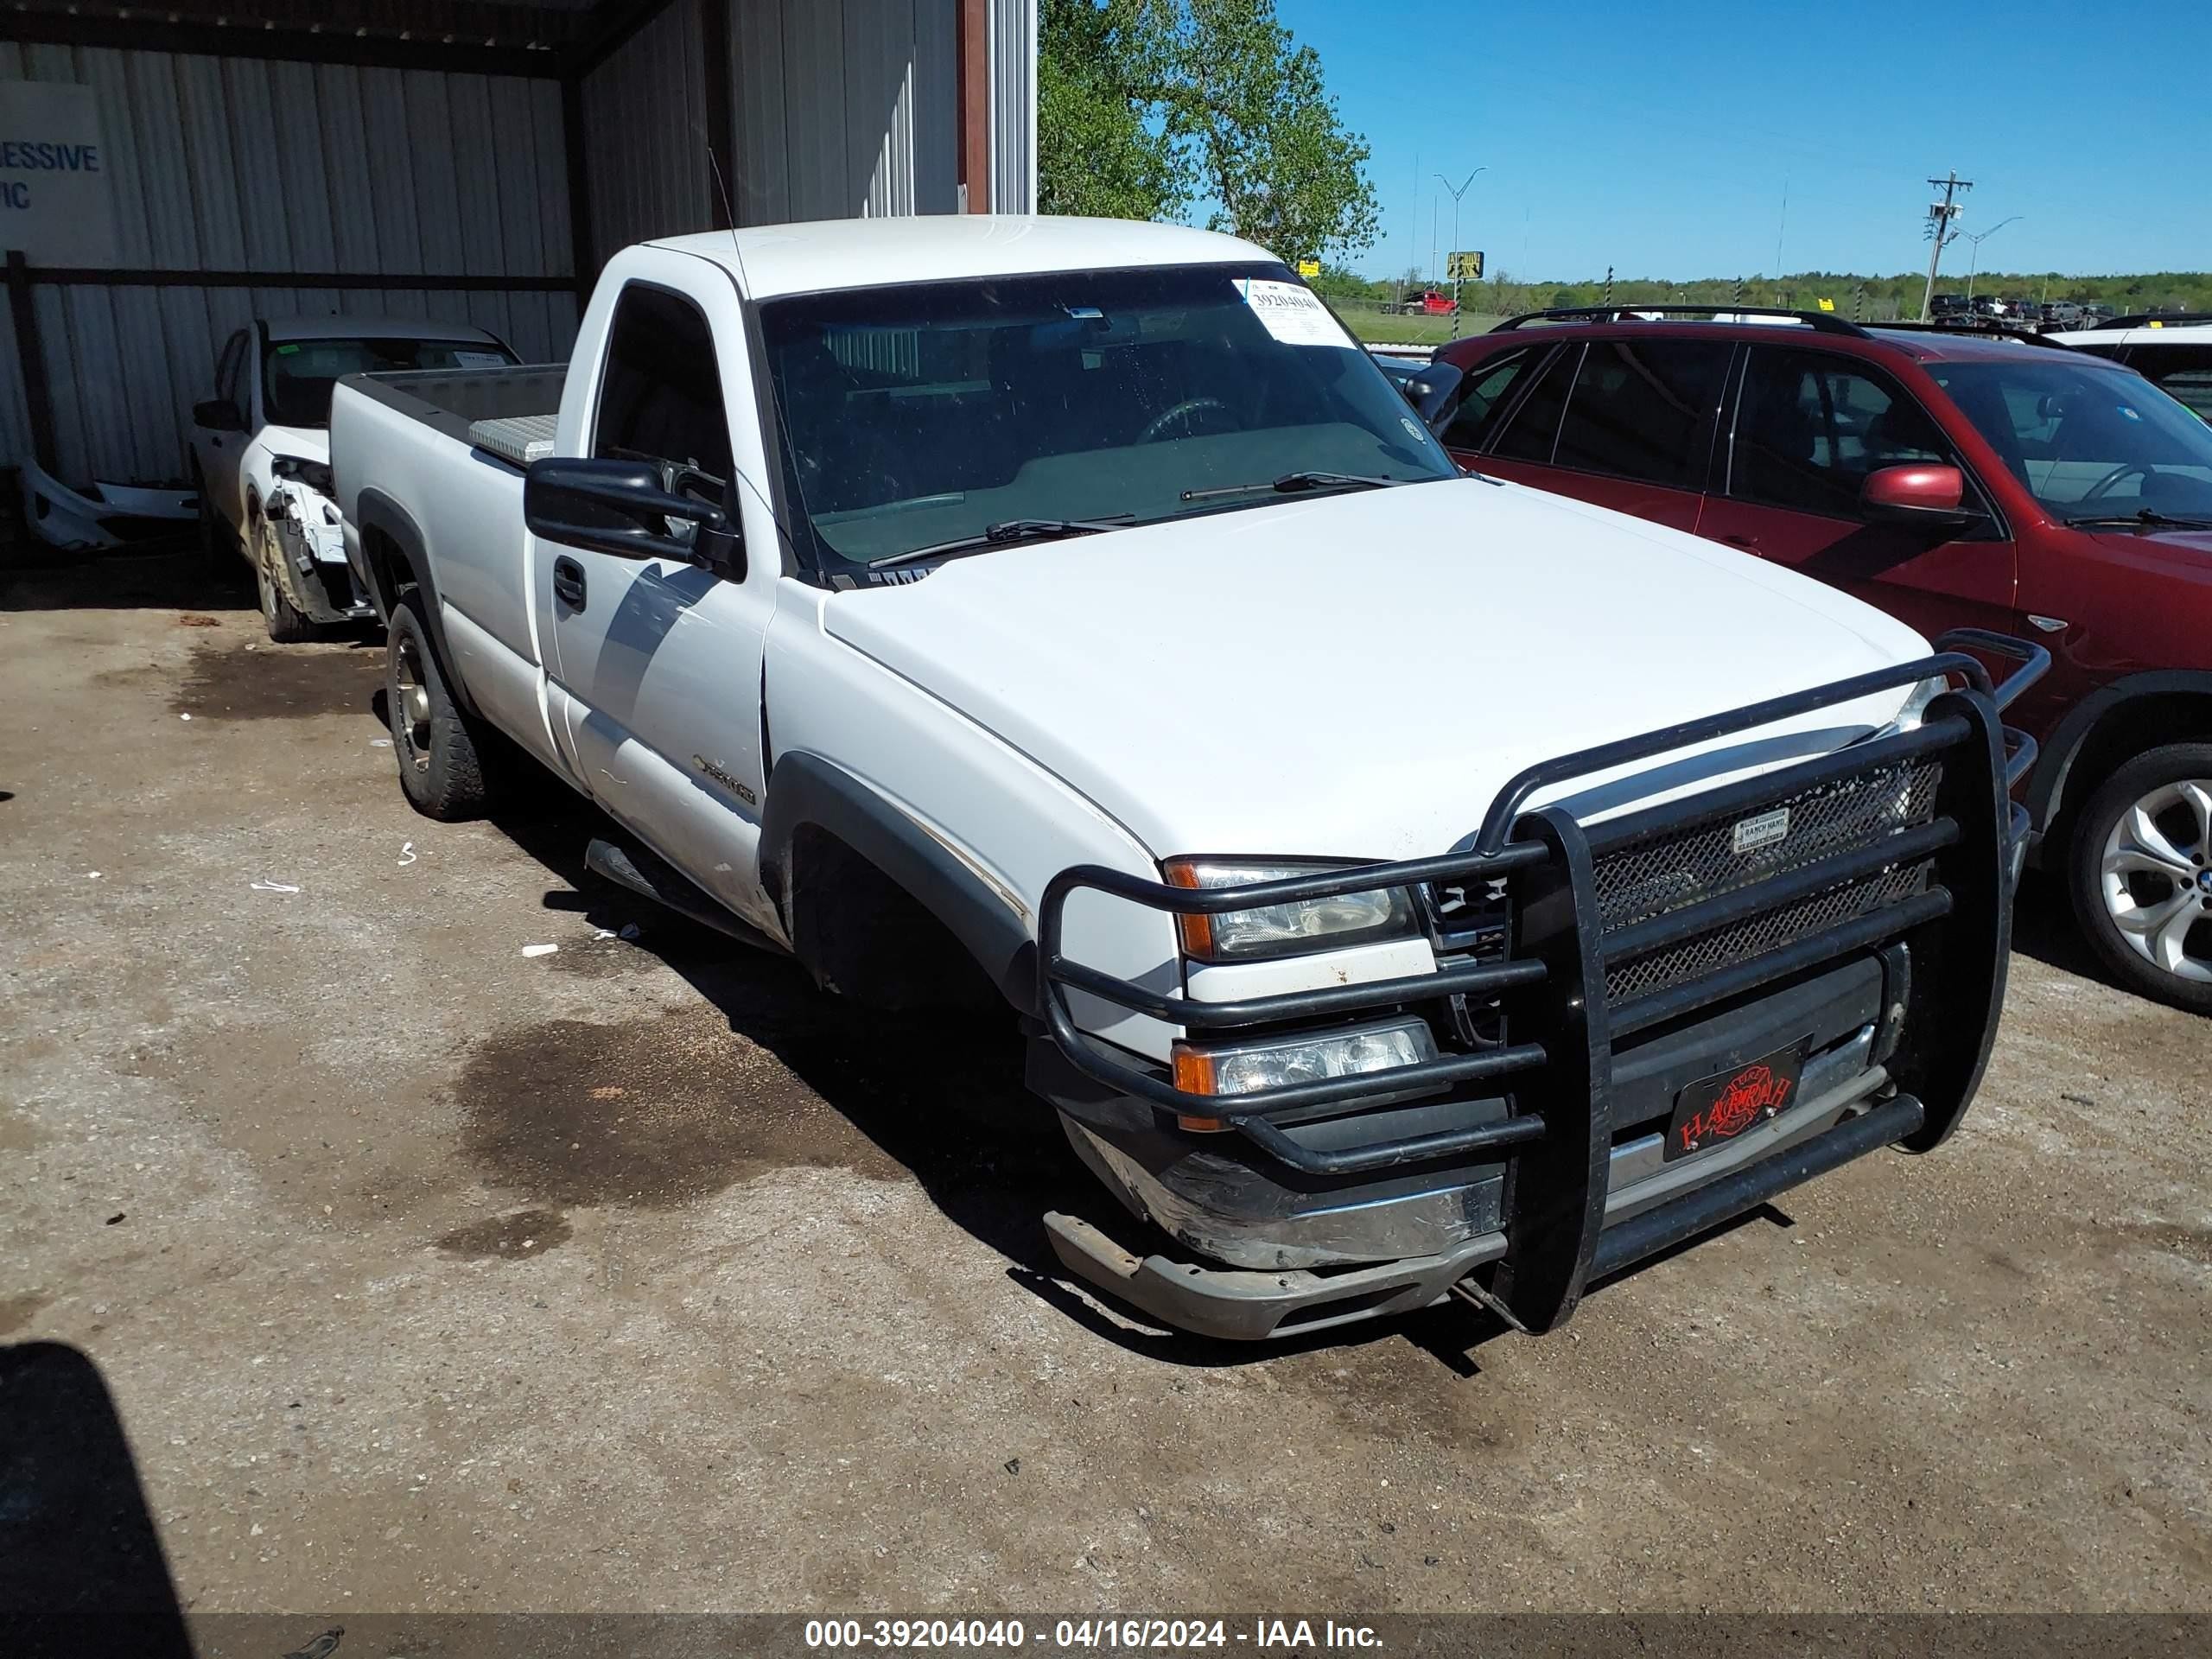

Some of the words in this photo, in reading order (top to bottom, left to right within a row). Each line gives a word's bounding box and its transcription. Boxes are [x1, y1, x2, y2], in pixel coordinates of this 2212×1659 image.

[0, 141, 100, 173] ESSIVE
[0, 180, 31, 209] IC
[1253, 294, 1319, 311] 39204040
[1745, 823, 1767, 836] RANCH
[1767, 817, 1784, 830] HAND
